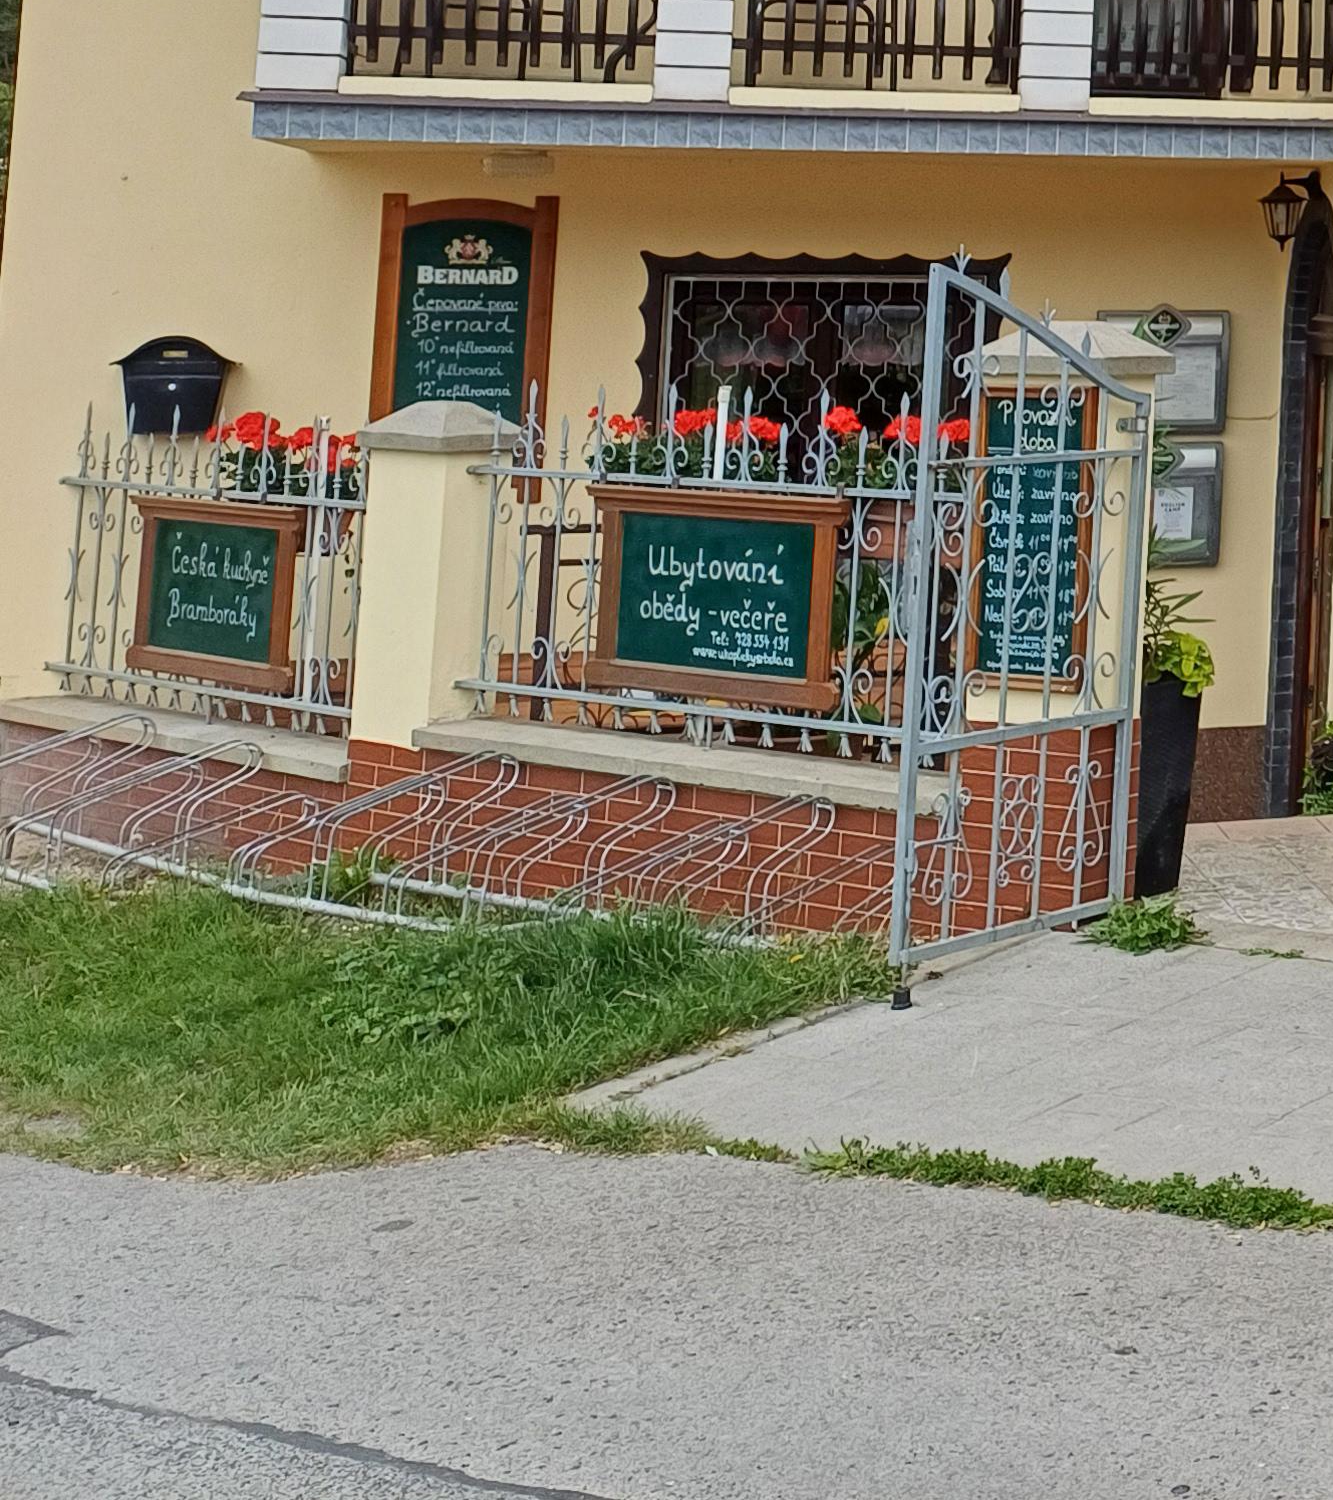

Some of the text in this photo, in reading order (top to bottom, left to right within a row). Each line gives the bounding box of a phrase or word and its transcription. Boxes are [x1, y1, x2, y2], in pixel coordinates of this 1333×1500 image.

[417, 265, 519, 285] BERNARD
[411, 312, 516, 338] Bernard
[171, 531, 270, 590] Česká kuchyně
[648, 543, 784, 592] Ubytování
[166, 587, 257, 642] Bramboráky
[639, 590, 701, 636] obědy
